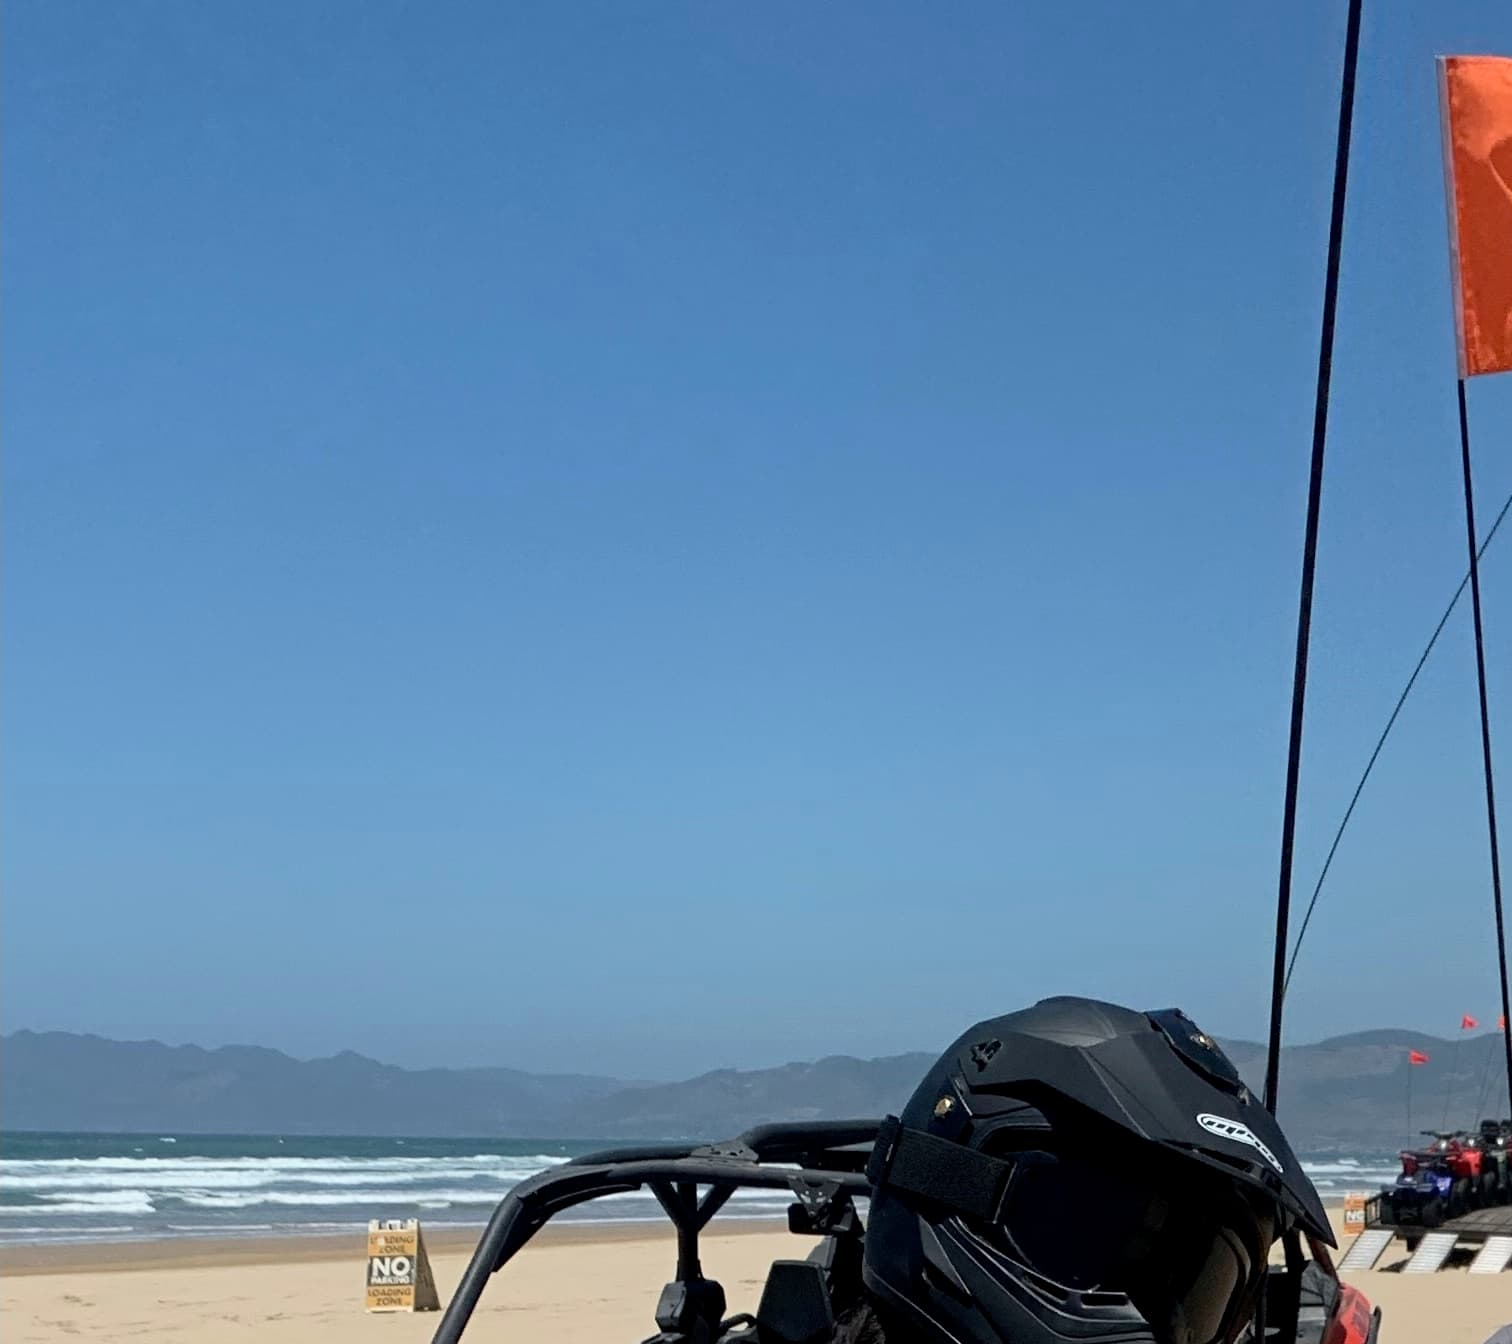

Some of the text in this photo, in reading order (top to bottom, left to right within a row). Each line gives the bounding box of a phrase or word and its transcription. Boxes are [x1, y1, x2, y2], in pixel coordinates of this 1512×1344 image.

[372, 1256, 410, 1277] NO
[368, 1287, 411, 1297] LOADING
[376, 1297, 402, 1306] ZONE
